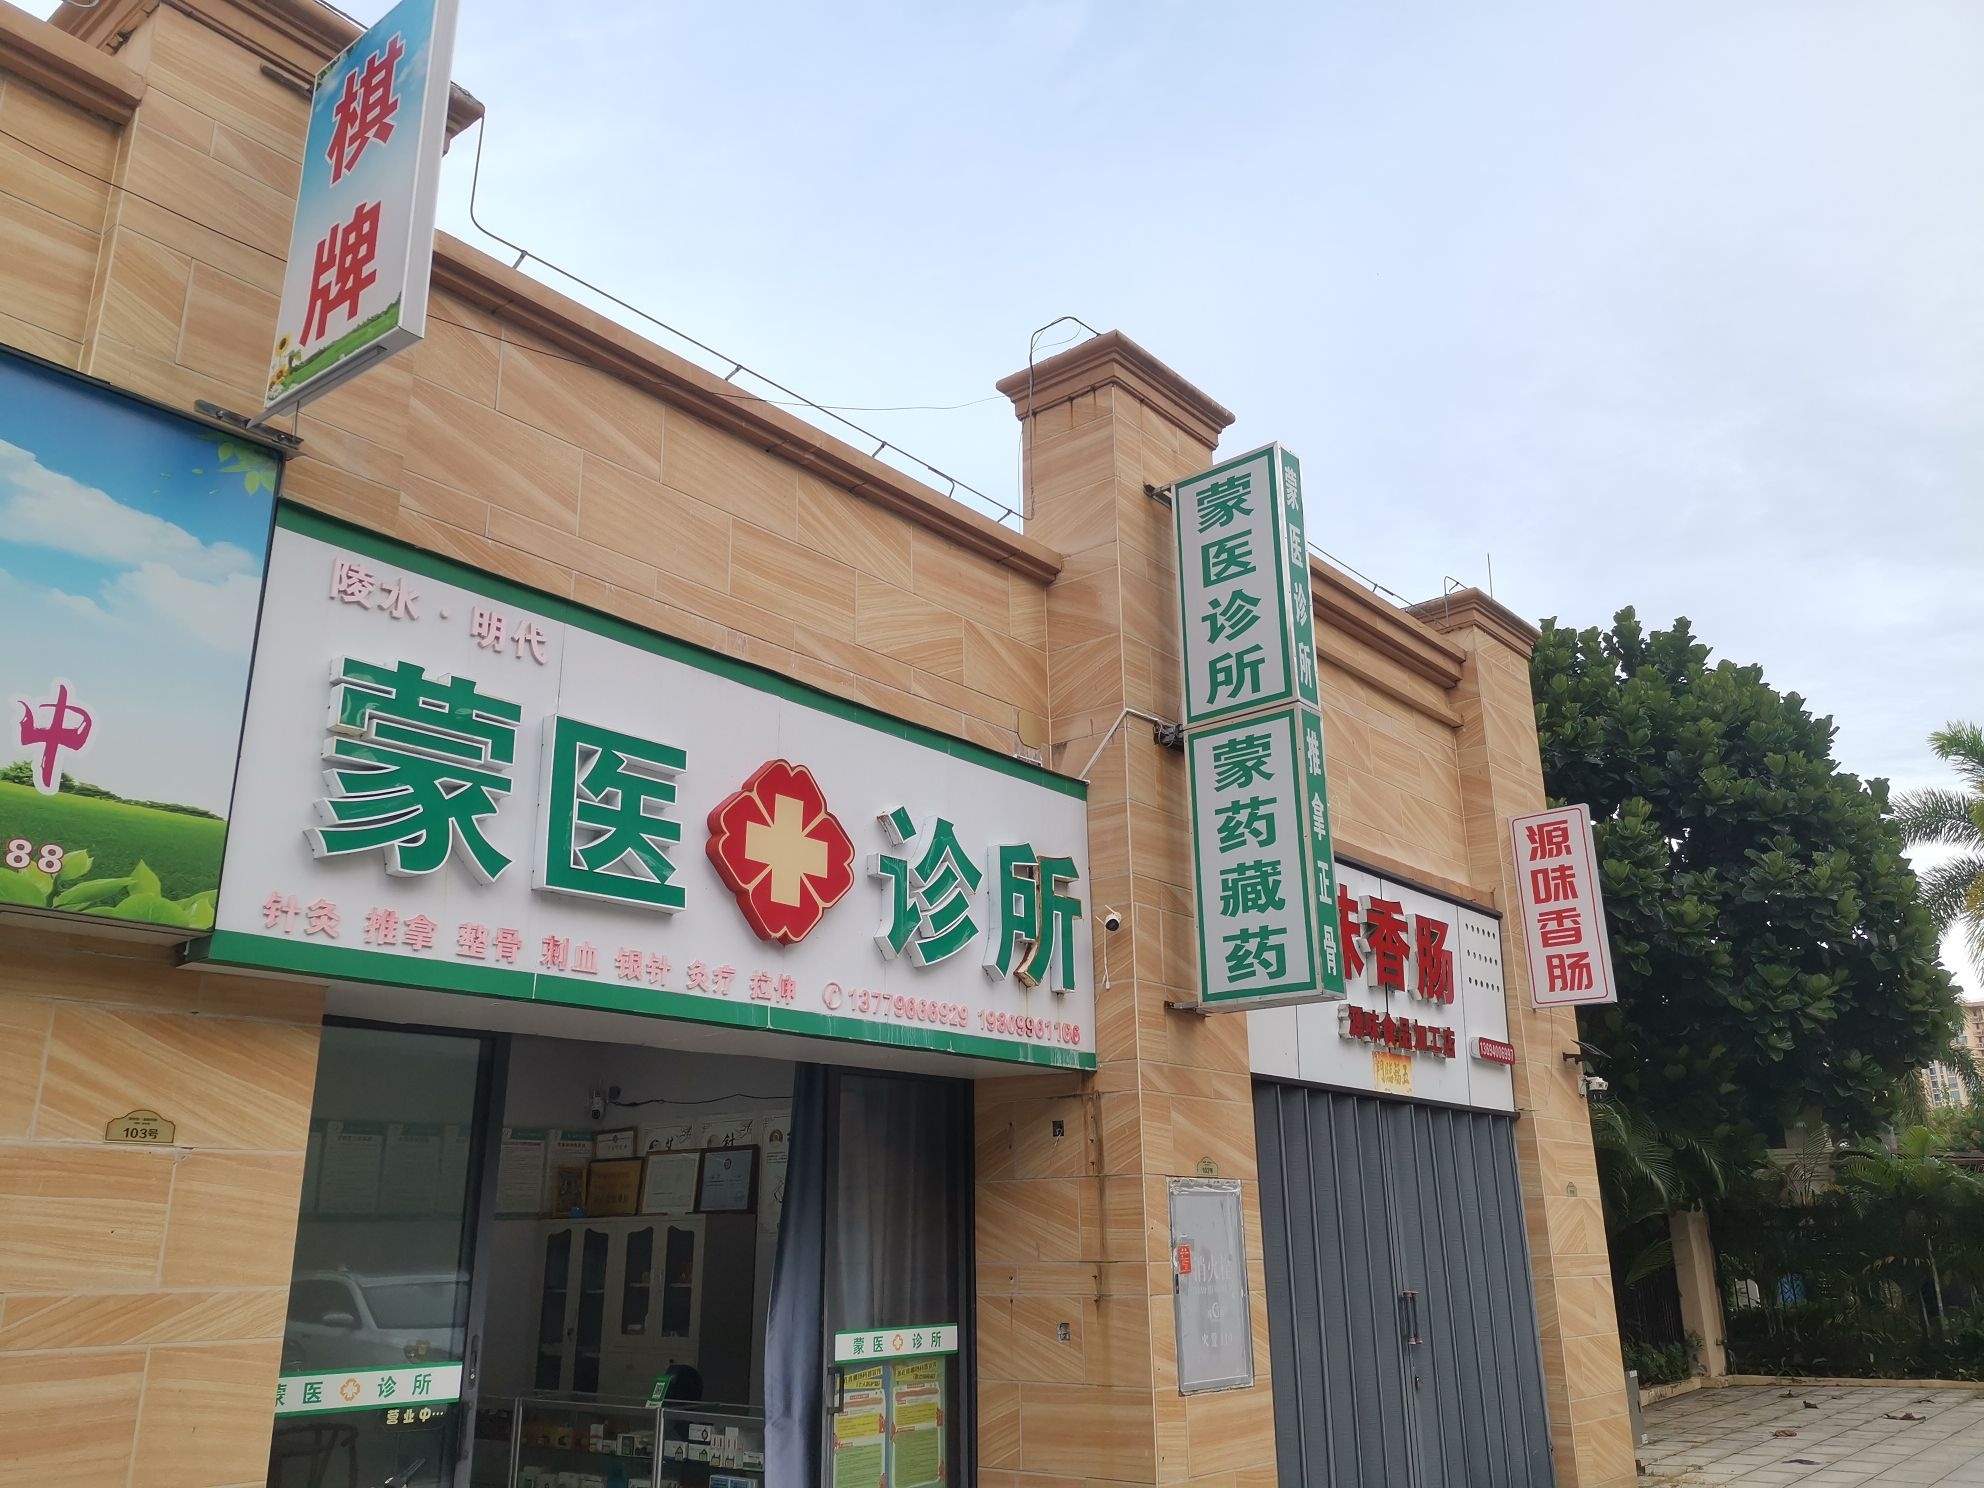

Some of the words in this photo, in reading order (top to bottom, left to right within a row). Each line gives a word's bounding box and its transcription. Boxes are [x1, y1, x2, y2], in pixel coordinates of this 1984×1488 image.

[299, 31, 405, 348] 棋牌
[1195, 471, 1266, 706] 蒙医诊所
[1284, 465, 1313, 689] 蒙医诊所
[16, 684, 92, 788] 中
[262, 890, 342, 940] 针灸
[363, 906, 439, 952] 推拿
[456, 921, 523, 964] 整骨
[539, 934, 600, 975] 刺血
[614, 946, 673, 987] 银针
[686, 959, 737, 996] 灸疗
[1211, 731, 1289, 985] 蒙药藏药
[1306, 727, 1337, 976] 推拿正骨
[1525, 821, 1594, 994] 源味香肠
[122, 1126, 159, 1140] 103号
